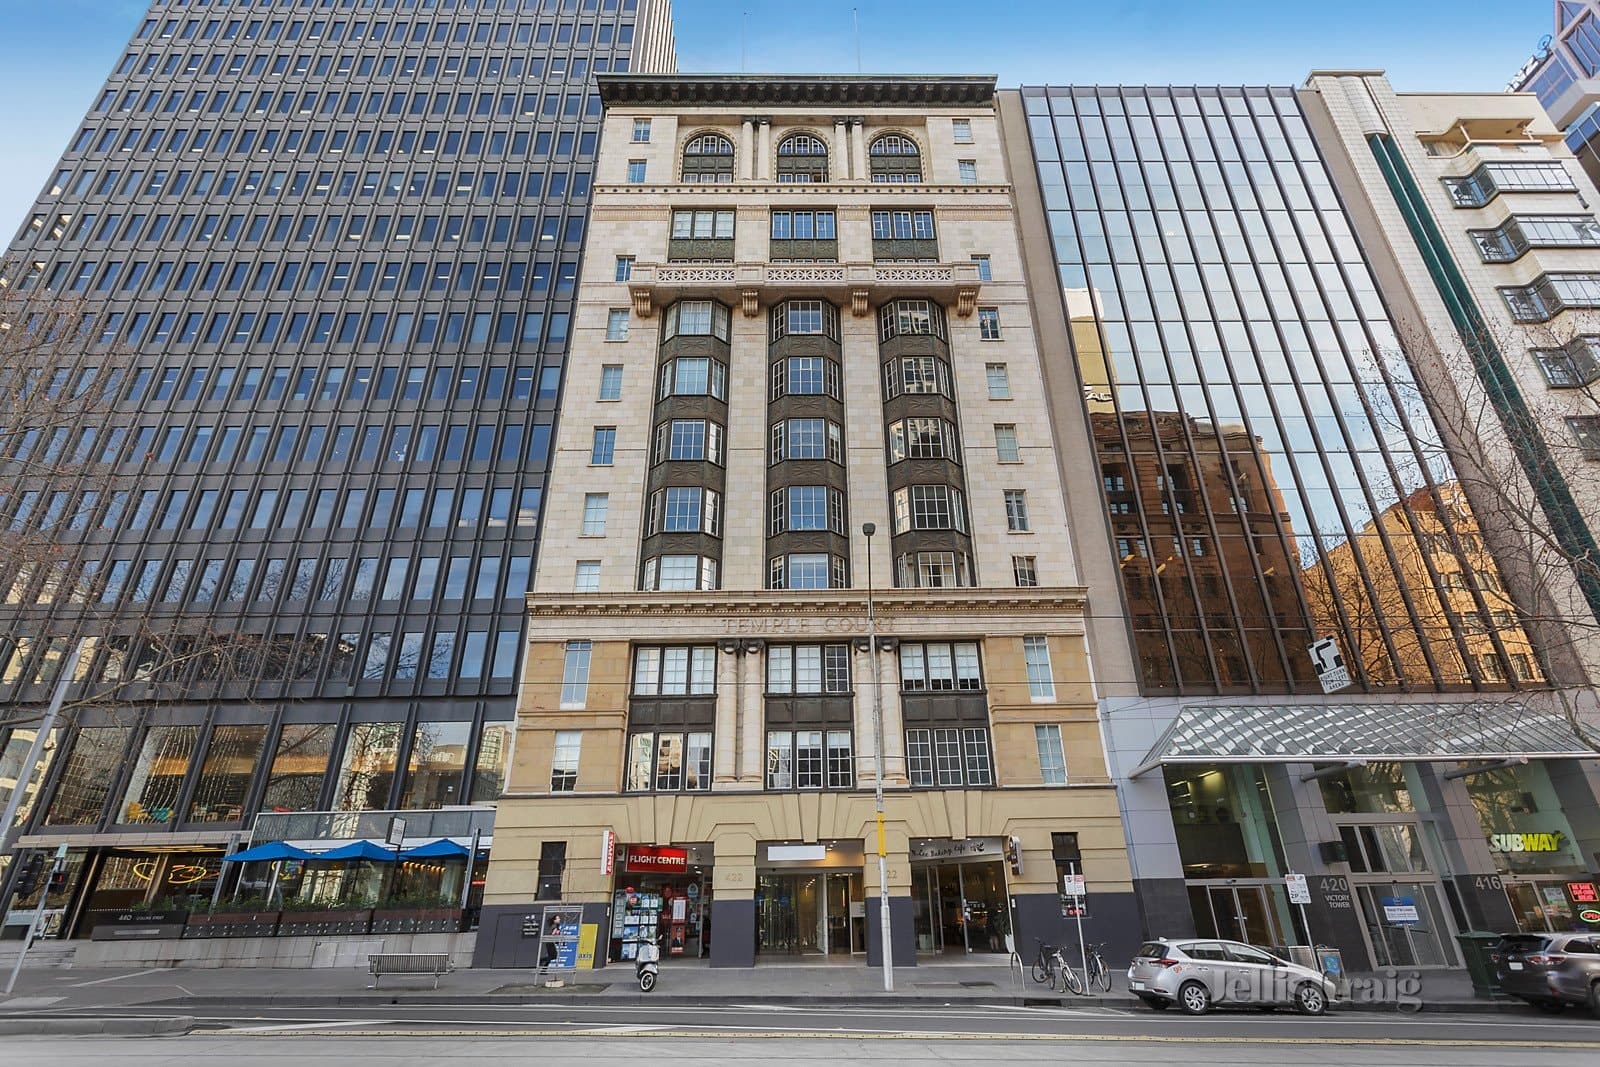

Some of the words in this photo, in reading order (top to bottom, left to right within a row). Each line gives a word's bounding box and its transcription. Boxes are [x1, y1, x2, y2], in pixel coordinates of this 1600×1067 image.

[722, 617, 810, 633] TEMPLE
[823, 617, 896, 633] COURT
[1489, 832, 1564, 852] SUBWAY
[629, 855, 657, 865] FLIGHT
[657, 856, 686, 866] CENTRE
[1320, 878, 1348, 891] 420
[1475, 877, 1501, 890] 416
[1328, 901, 1351, 909] TOWER
